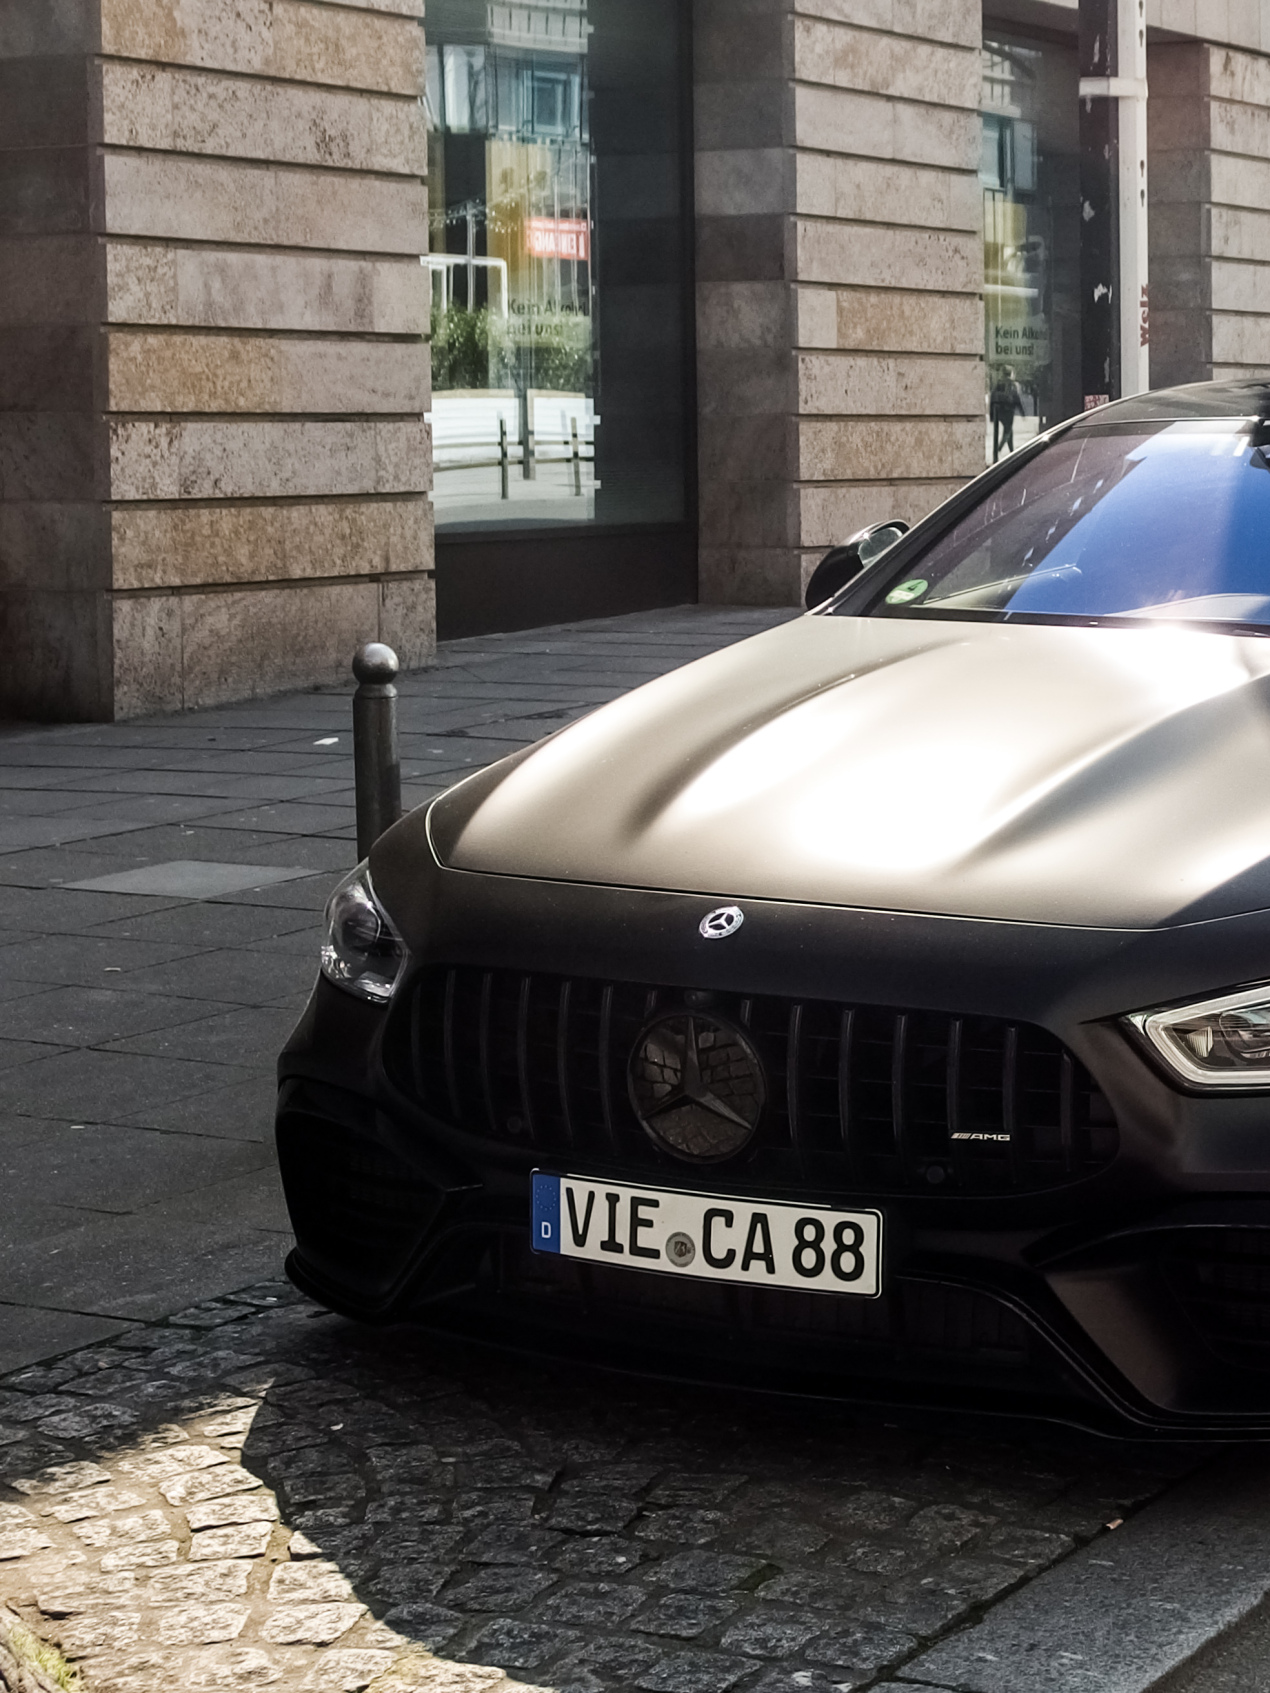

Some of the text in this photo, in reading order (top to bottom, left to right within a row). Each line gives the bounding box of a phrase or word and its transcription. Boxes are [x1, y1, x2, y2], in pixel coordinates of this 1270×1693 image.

[995, 326, 1019, 339] Kein
[995, 341, 1013, 355] bei
[969, 1133, 1010, 1141] AMG
[541, 1221, 552, 1239] D
[565, 1187, 865, 1282] VIE CA 88
